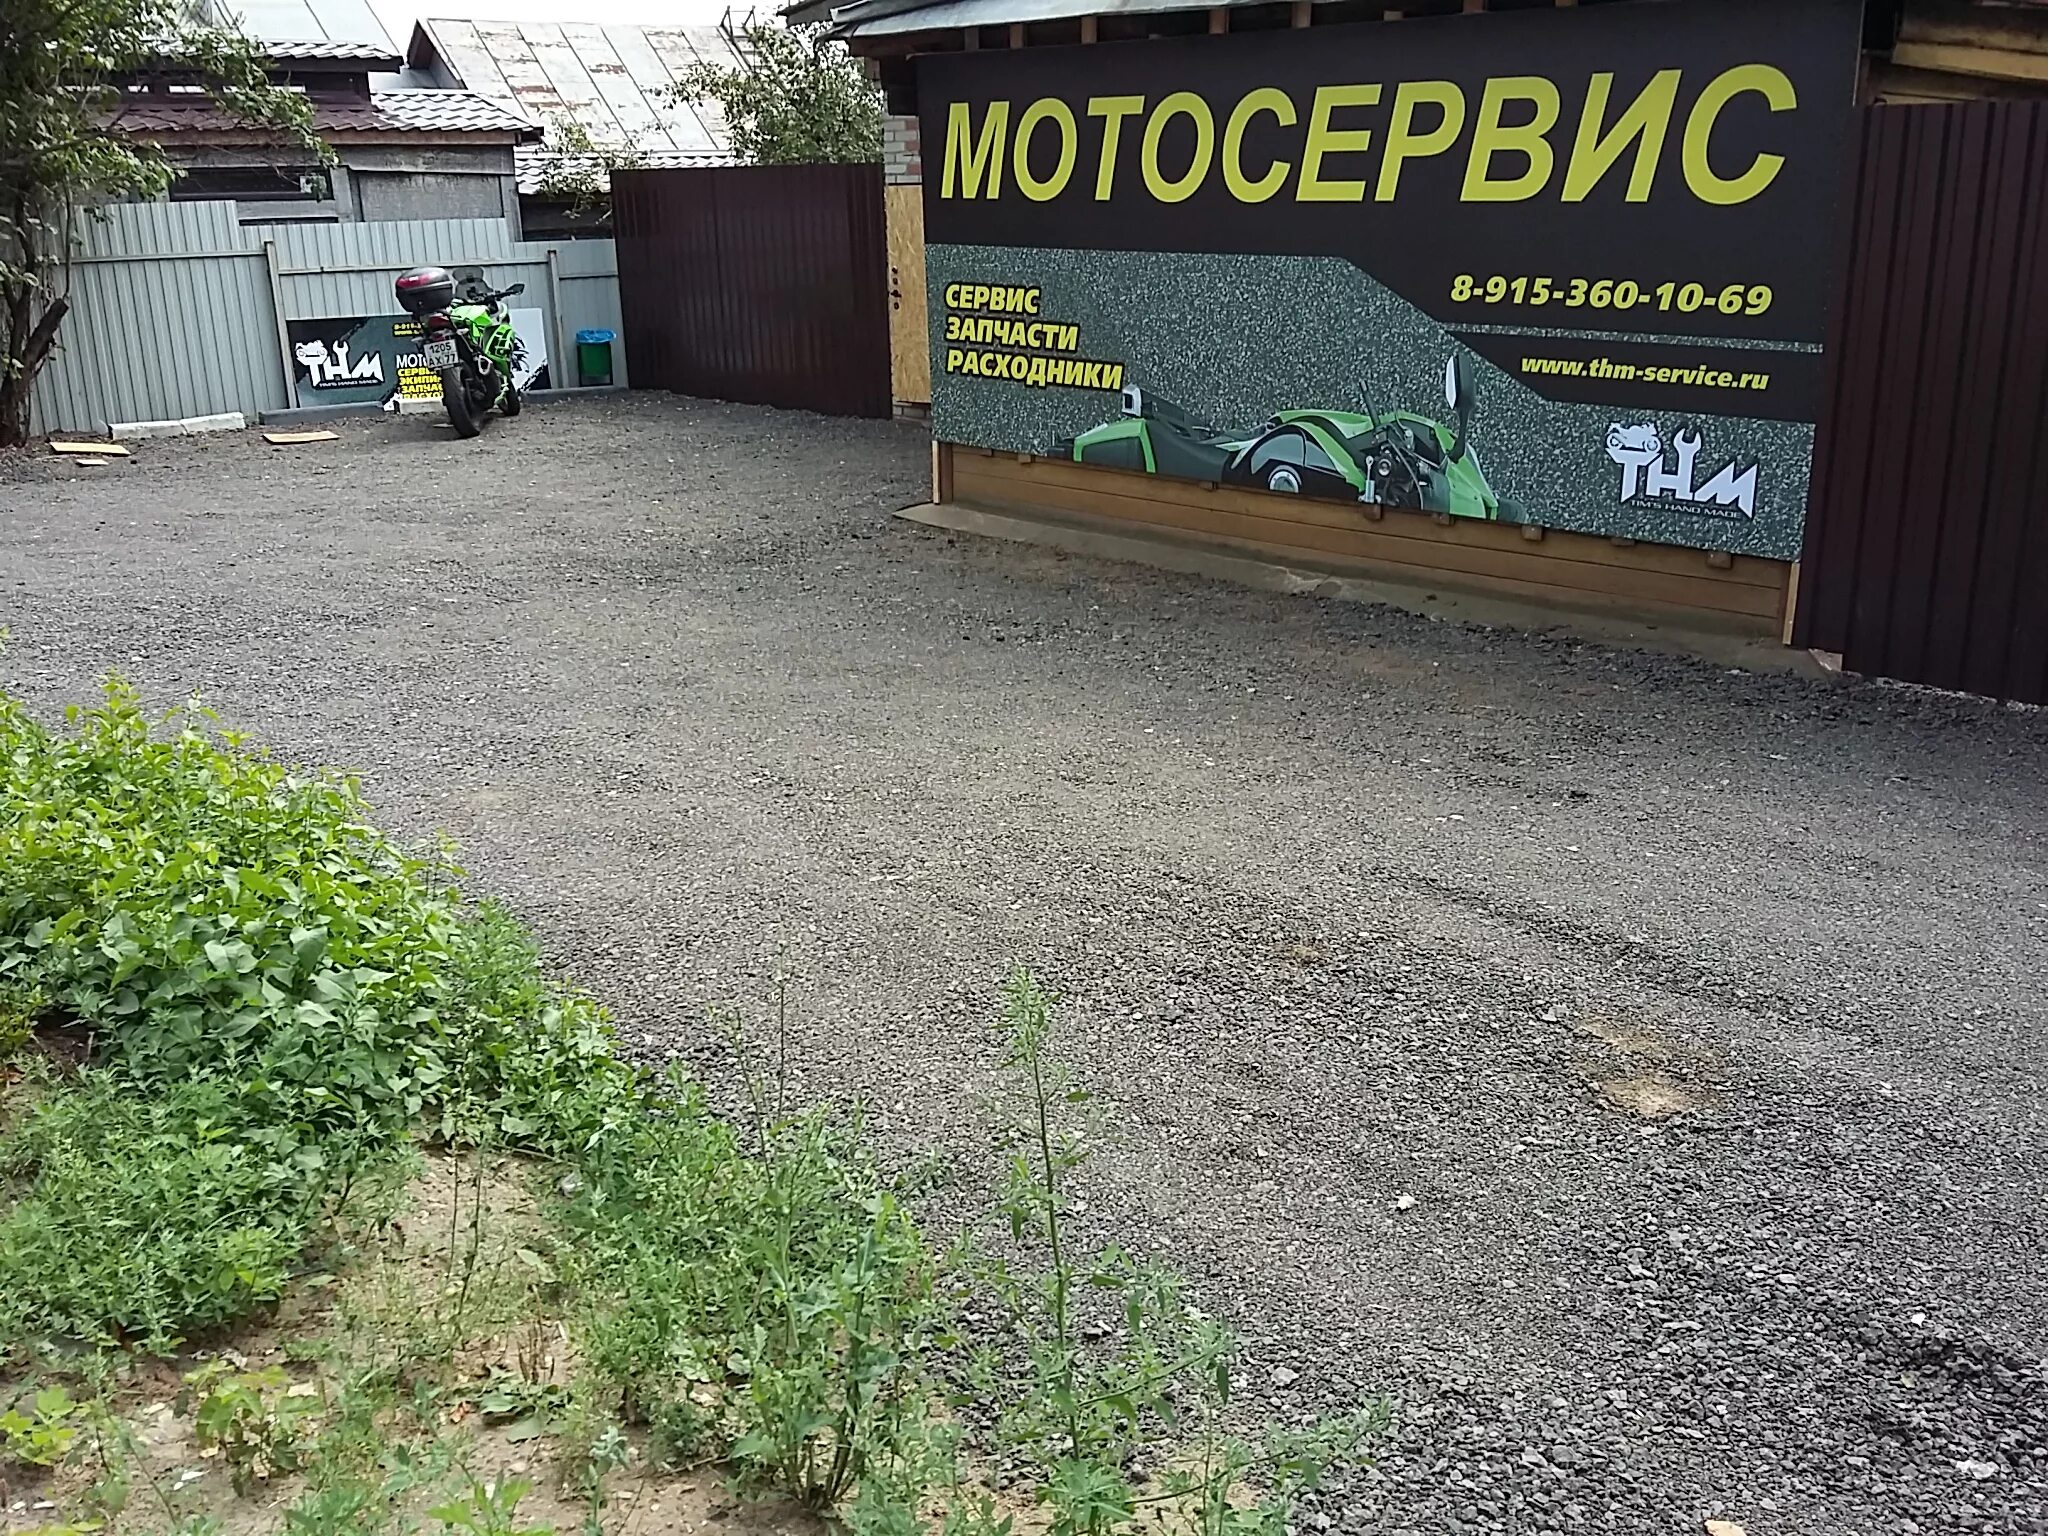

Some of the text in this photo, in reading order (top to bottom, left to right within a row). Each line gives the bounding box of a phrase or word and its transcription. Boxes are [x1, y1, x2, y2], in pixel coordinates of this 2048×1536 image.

[941, 64, 1797, 206] МОТОСЕРВИС
[945, 284, 1040, 315] СЕРВИС
[1450, 274, 1773, 316] 8-915-360-10-69
[429, 342, 451, 354] 1205
[946, 316, 1079, 351] ЗАПЧАСТИ
[444, 353, 456, 364] 77
[947, 349, 1124, 391] РАСХОДНИКИ
[1521, 356, 1769, 390] www.thm-service.ru
[1665, 503, 1700, 514] HAND
[1704, 508, 1742, 519] MADE
